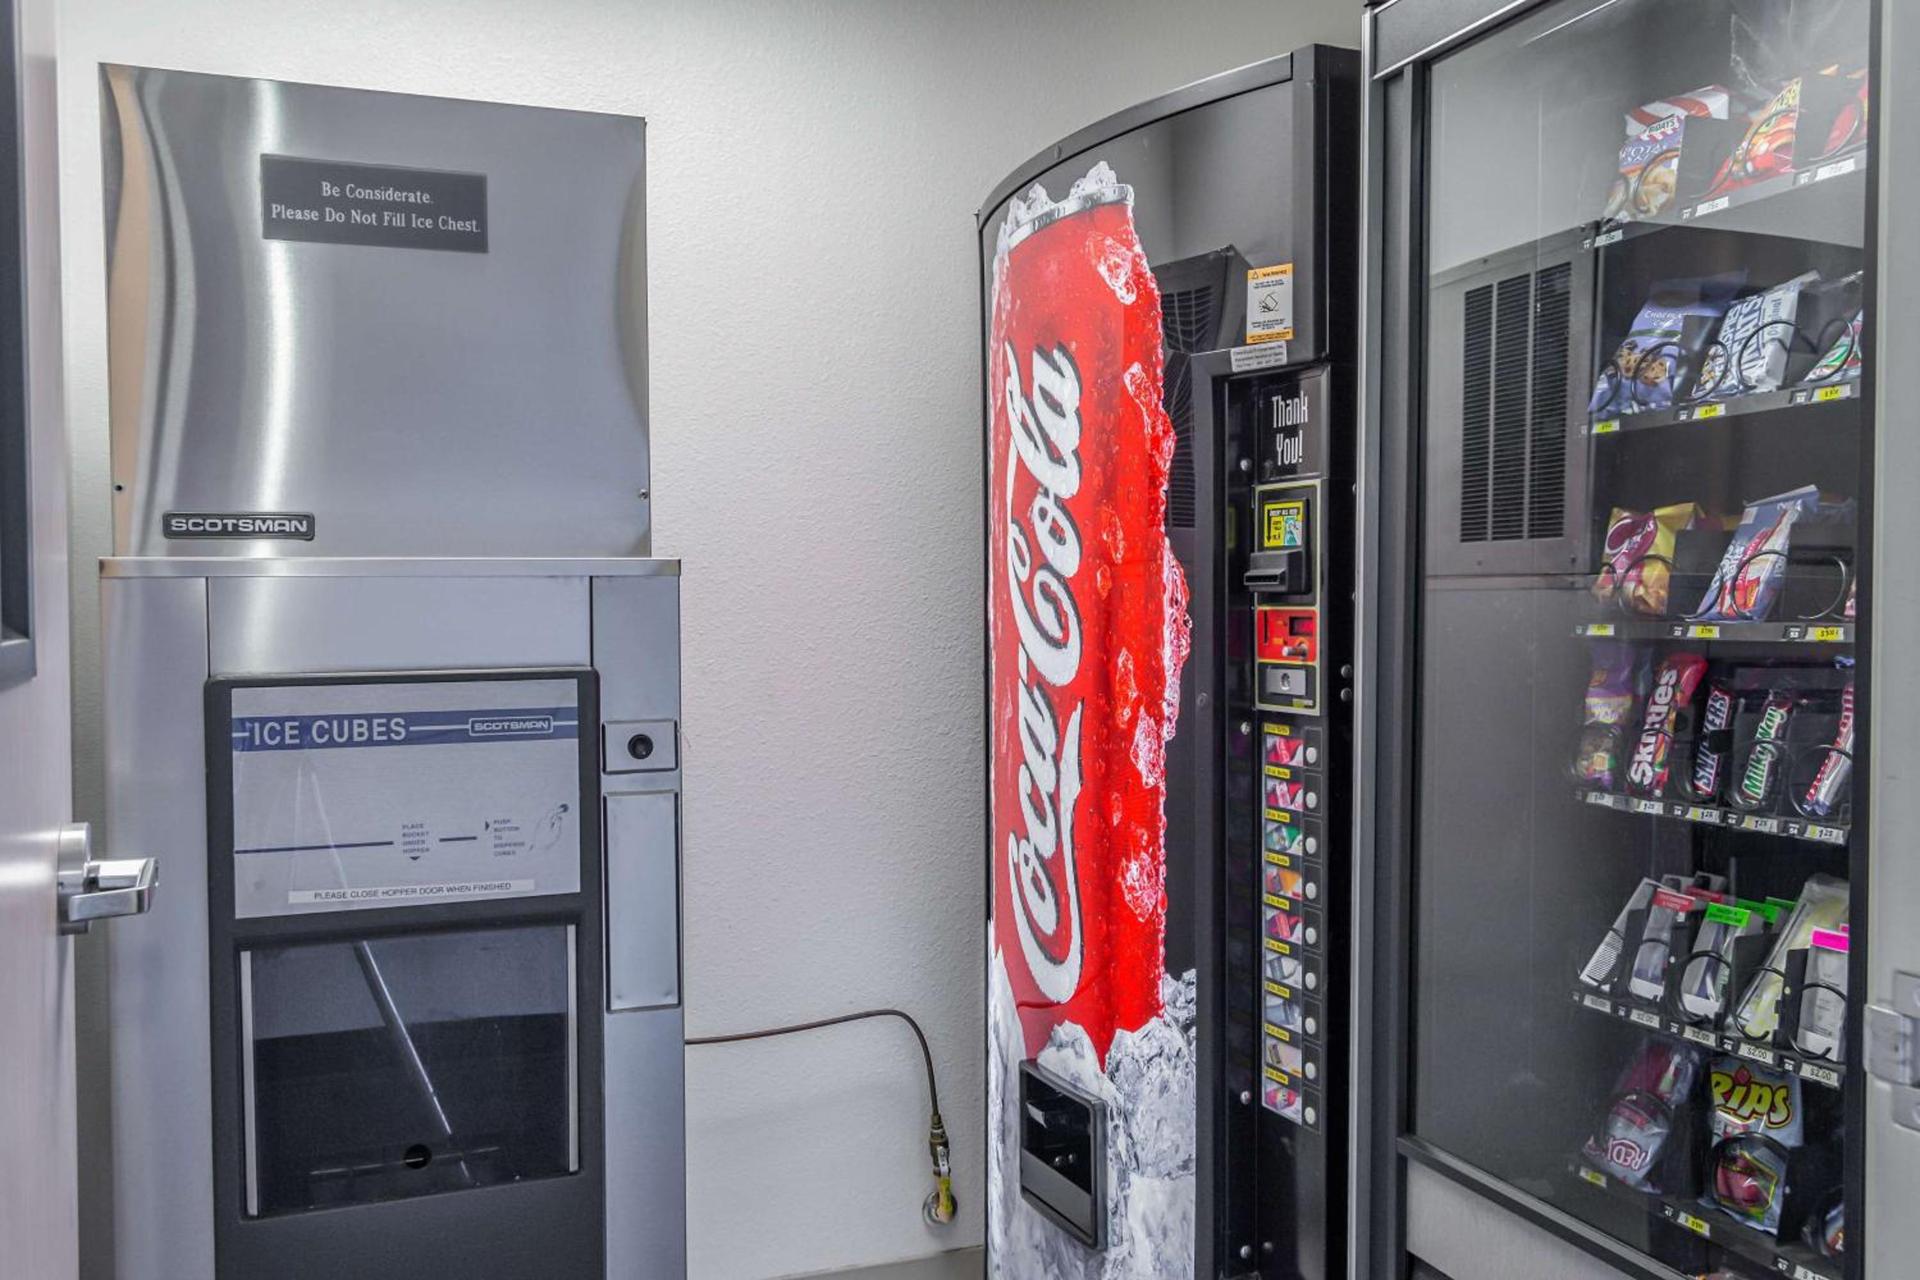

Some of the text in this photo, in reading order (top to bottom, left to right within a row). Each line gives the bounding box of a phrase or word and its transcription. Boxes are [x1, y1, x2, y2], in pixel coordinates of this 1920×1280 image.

[321, 181, 433, 204] Be Considerate.
[271, 203, 481, 233] Please Do Not Fill Ice Chest.
[1271, 390, 1309, 428] Thank
[1276, 430, 1304, 466] You!
[170, 518, 308, 534] SCOTSMAN
[1003, 340, 1085, 1005] Coca-Cola
[254, 717, 549, 746] ICE CUBES SCOTSMAN
[1742, 706, 1787, 798] Milky Way
[314, 882, 512, 900] PLEASE CLOSE HOPPER DOOR WHEN FINISHED
[1746, 1046, 1767, 1060] $2.00
[1810, 1067, 1832, 1082] $2.00
